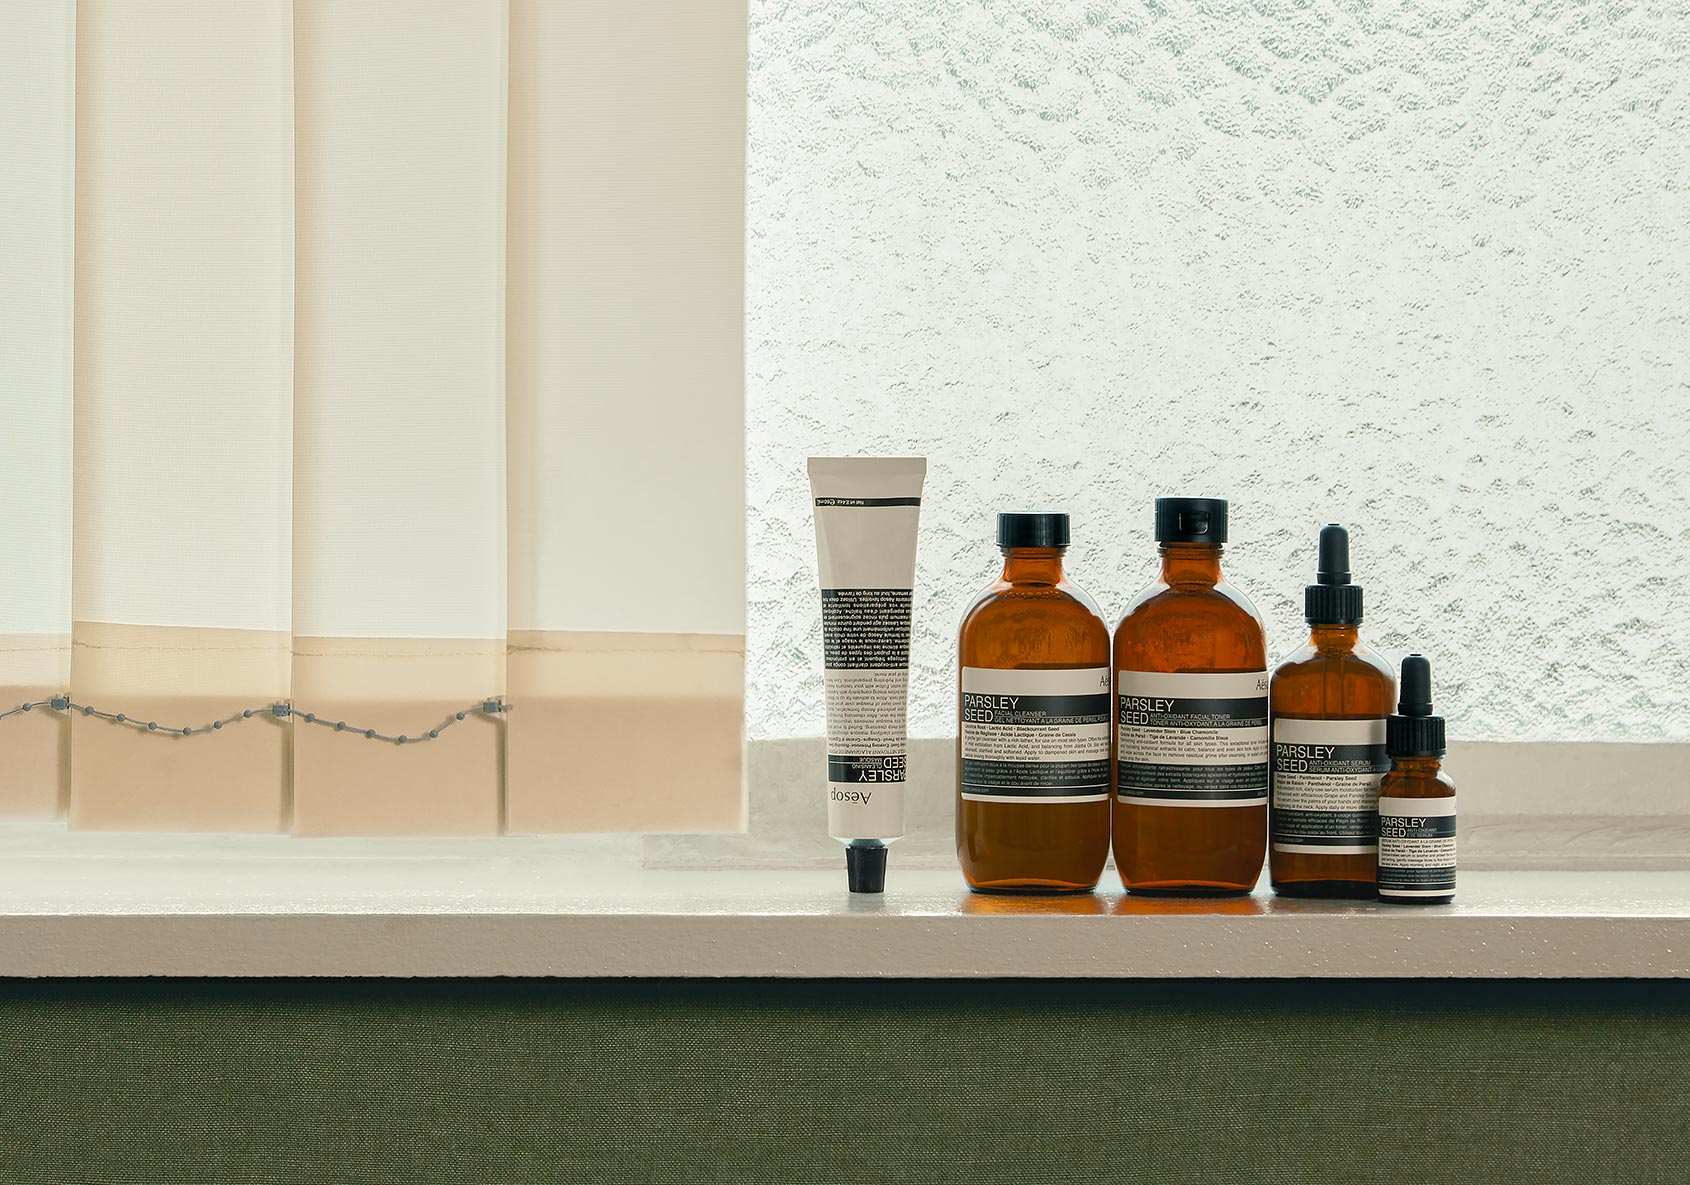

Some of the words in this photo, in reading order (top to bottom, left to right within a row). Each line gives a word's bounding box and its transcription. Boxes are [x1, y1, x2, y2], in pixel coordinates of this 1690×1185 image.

[964, 694, 1019, 709] PARSLEY
[1121, 697, 1174, 712] PARSLEY
[964, 708, 993, 722] SEED
[1121, 711, 1148, 724] SEED
[1277, 745, 1335, 759] PARSLEY
[1277, 758, 1308, 772] SEED
[831, 787, 872, 805] Aësop
[1382, 817, 1426, 827] PARSLEY
[1382, 827, 1406, 837] SEED
